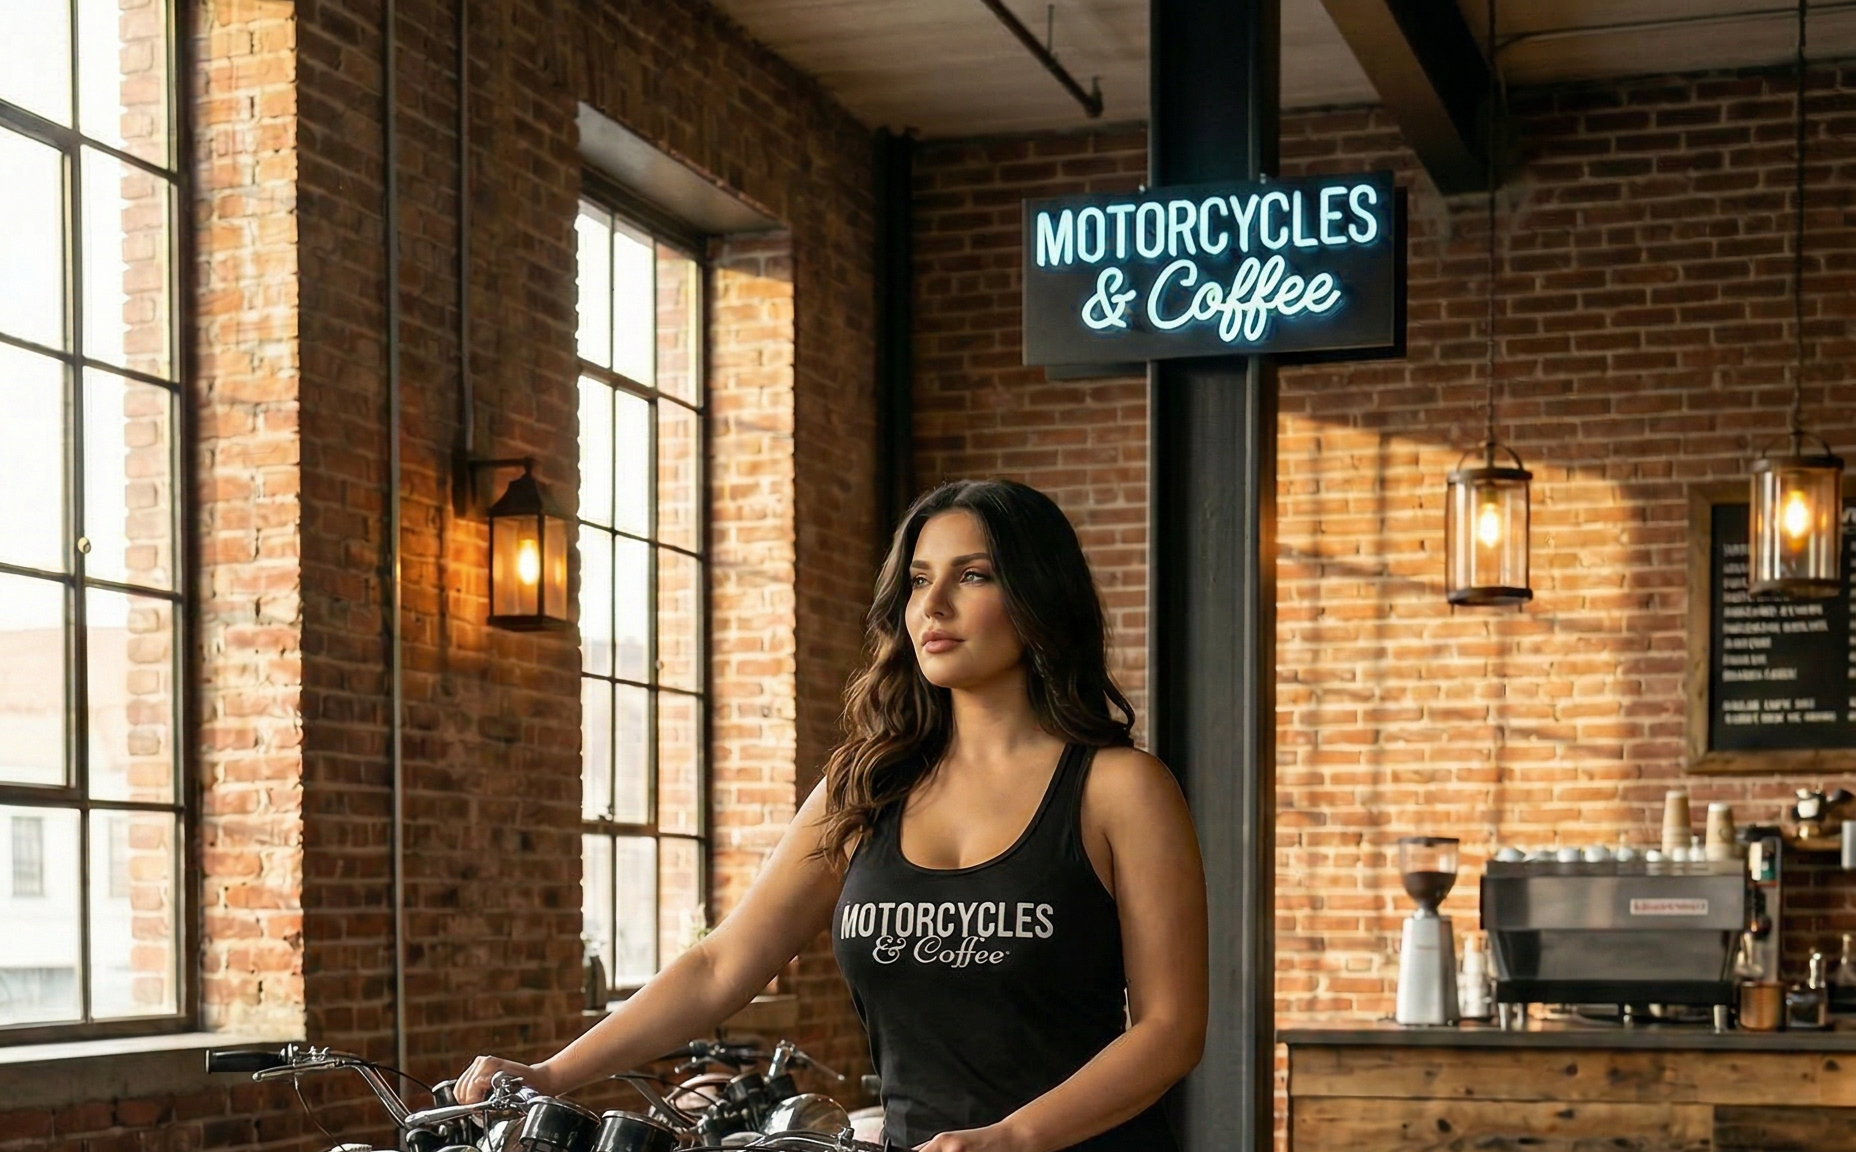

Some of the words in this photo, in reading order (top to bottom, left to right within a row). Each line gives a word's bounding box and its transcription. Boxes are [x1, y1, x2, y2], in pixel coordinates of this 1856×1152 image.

[1037, 184, 1377, 267] MOTORCYCLES
[1081, 267, 1136, 329] &
[1148, 255, 1341, 342] Coffee
[841, 901, 1054, 939] MOTORCYCLES
[873, 935, 906, 964] &
[913, 935, 1005, 968] Coffee
